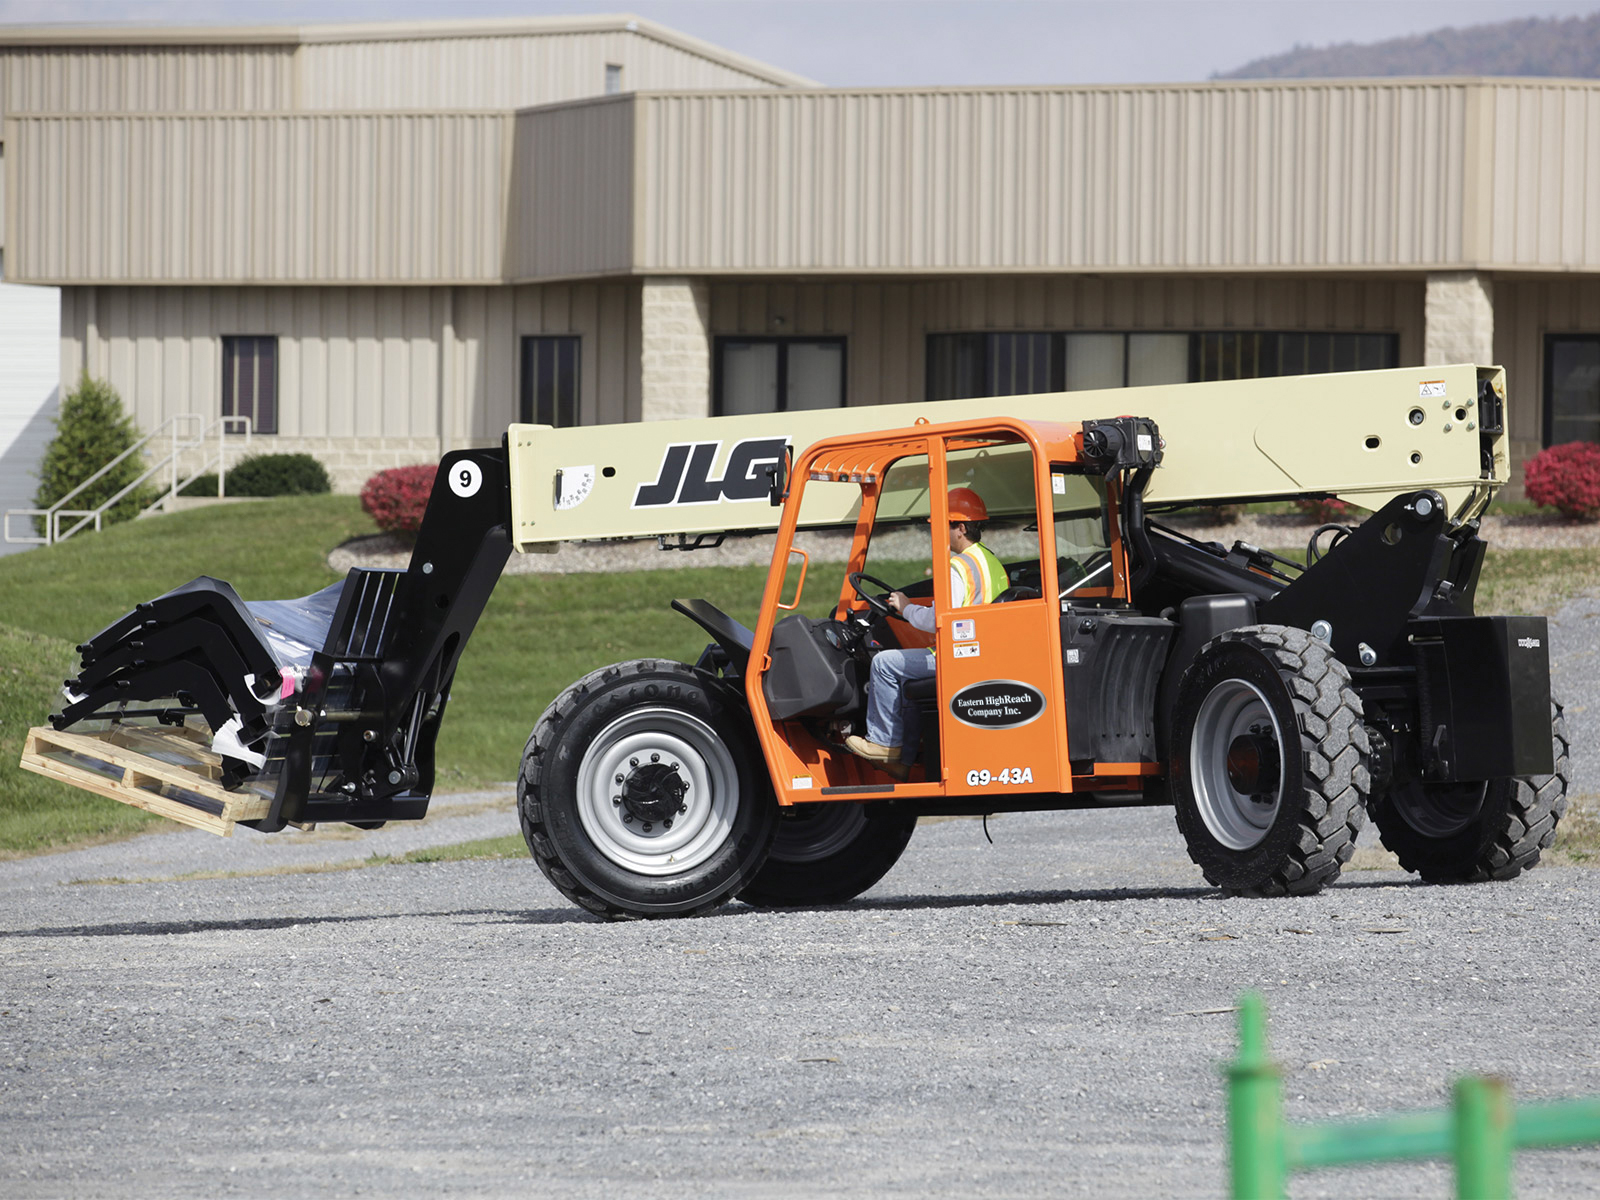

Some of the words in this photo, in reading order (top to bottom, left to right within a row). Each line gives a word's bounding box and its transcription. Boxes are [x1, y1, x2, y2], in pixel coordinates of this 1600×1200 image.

[459, 470, 472, 488] 9
[632, 436, 789, 508] JLG
[957, 698, 984, 708] Eastern
[985, 692, 1032, 707] HighReach
[967, 708, 1003, 719] Company
[1004, 706, 1022, 716] Inc.
[966, 767, 1034, 787] G9-43A
